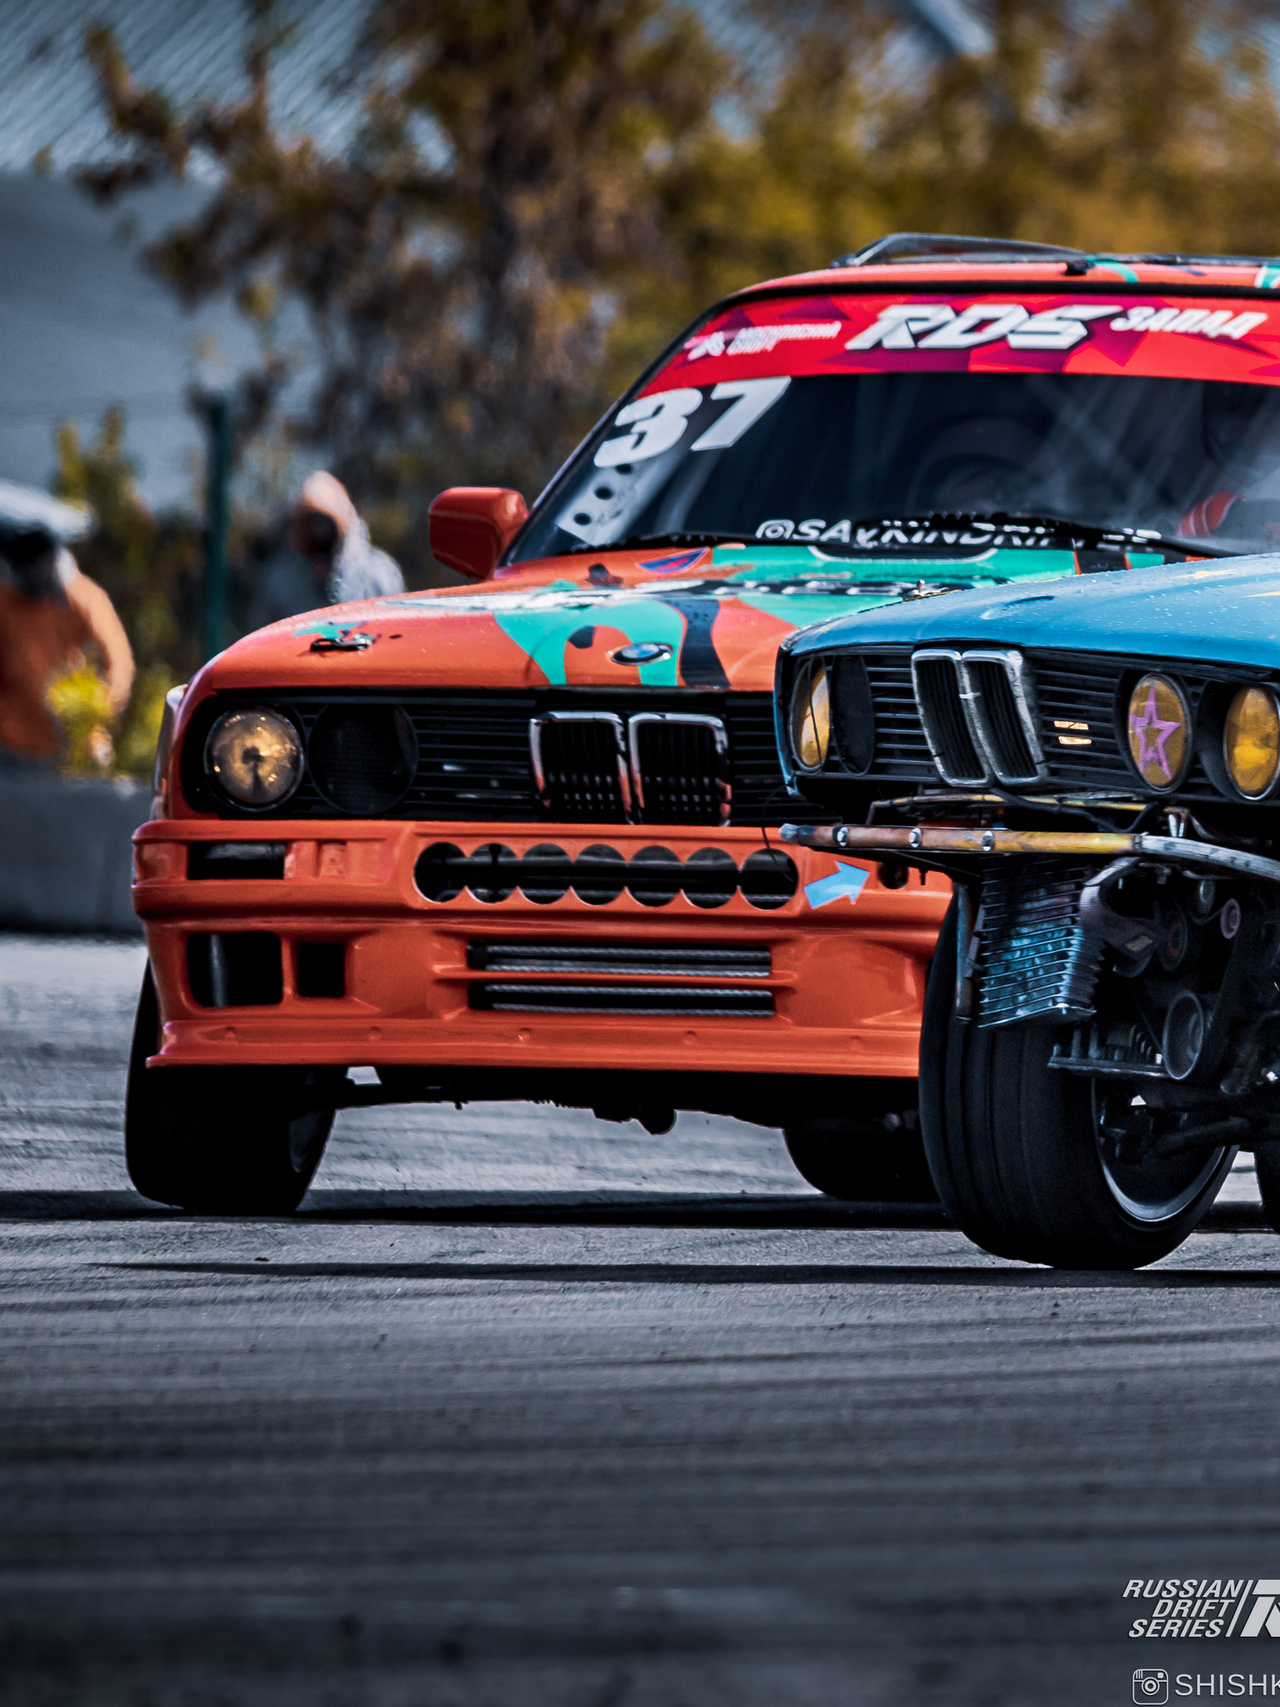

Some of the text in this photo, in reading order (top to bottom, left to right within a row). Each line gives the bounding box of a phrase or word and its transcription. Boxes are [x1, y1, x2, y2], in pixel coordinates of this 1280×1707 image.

[844, 304, 1123, 350] RDS
[1110, 306, 1268, 340] ЗАПАД
[593, 375, 792, 468] 37
